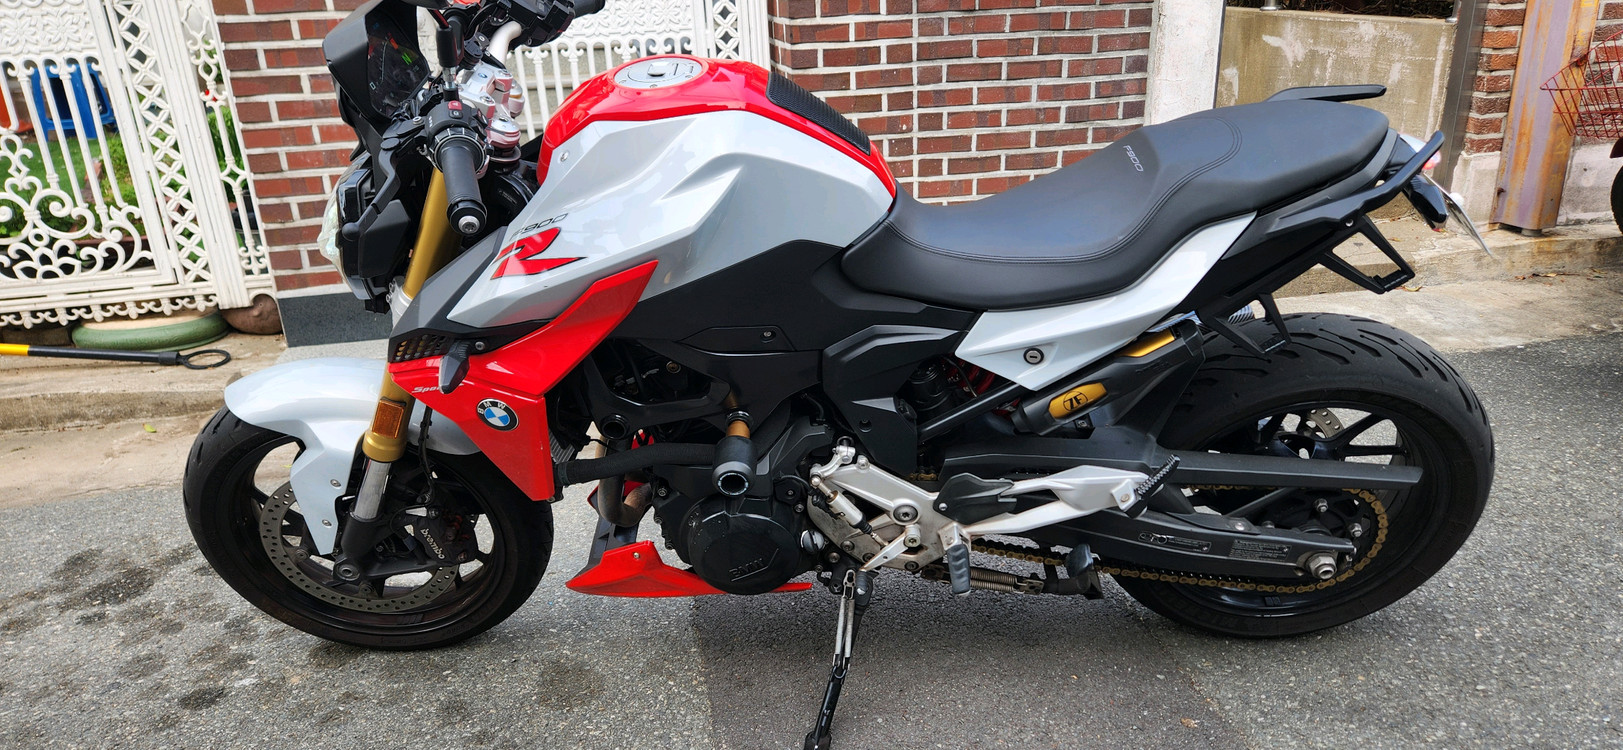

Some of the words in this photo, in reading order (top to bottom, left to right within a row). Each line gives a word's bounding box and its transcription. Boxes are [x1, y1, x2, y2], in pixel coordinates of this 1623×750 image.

[1122, 144, 1144, 172] F900
[490, 226, 588, 280] R
[477, 400, 506, 415] BMW
[1064, 391, 1085, 411] ZF
[420, 528, 445, 559] brembo
